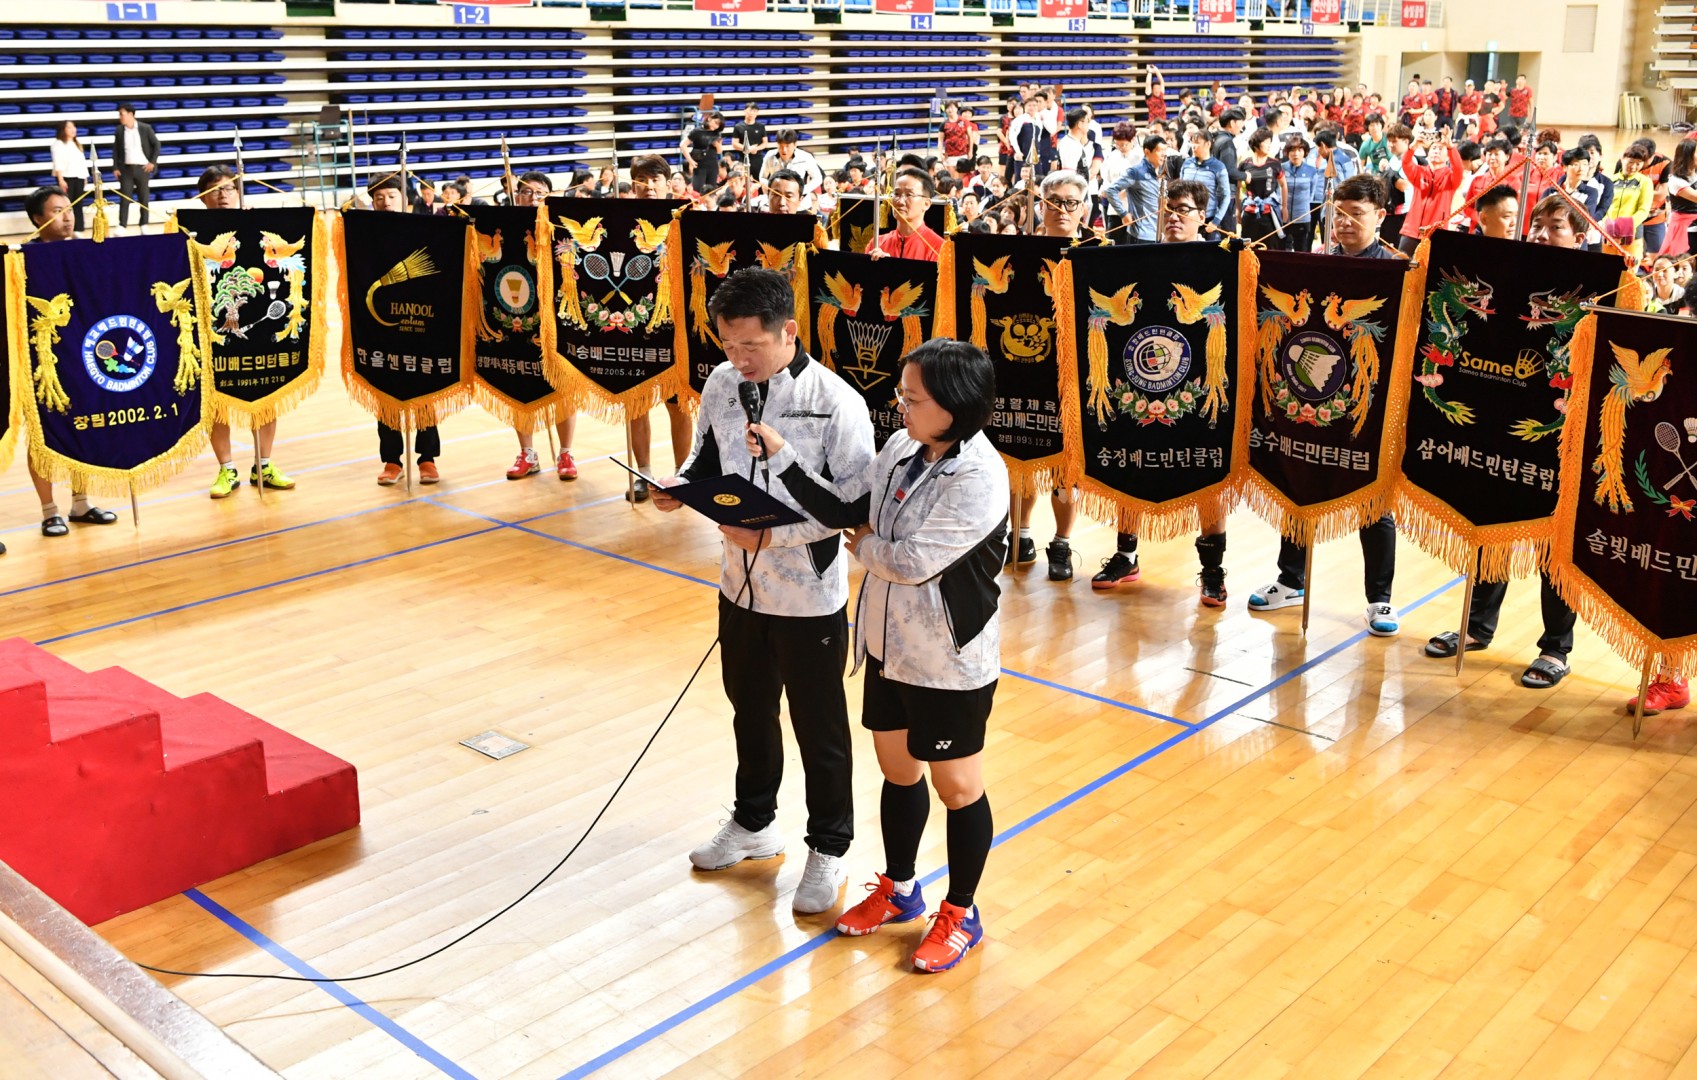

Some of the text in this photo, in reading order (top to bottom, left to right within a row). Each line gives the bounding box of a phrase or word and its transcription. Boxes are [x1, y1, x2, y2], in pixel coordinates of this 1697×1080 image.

[115, 3, 148, 19] 1-1
[459, 7, 485, 24] 1-2
[714, 13, 735, 26] 1-3
[914, 16, 930, 29] 1-4
[1071, 19, 1084, 31] 1-5
[1197, 22, 1209, 33] 1-6
[1303, 24, 1313, 35] 1-7
[390, 302, 434, 317] HANOOL
[566, 342, 671, 362] 재송배드민턴클럽
[106, 366, 152, 391] BADMINTON
[146, 341, 156, 364] CLUB
[212, 351, 301, 372] 山배드민턴클럽
[501, 359, 544, 376] 좌동배드민
[604, 368, 646, 377] 2005.4.24
[1147, 369, 1183, 390] BADMINTON
[1480, 371, 1511, 384] Badminton
[1512, 378, 1527, 388] Club
[73, 413, 105, 430] 창립
[171, 403, 178, 416] 1
[987, 411, 1064, 433] 운대배드민턴
[1097, 446, 1223, 469] 송정배드민턴클럽
[1249, 427, 1370, 471] 송수배드민턴클럽
[1416, 437, 1555, 491] 삼어배드민턴클럽
